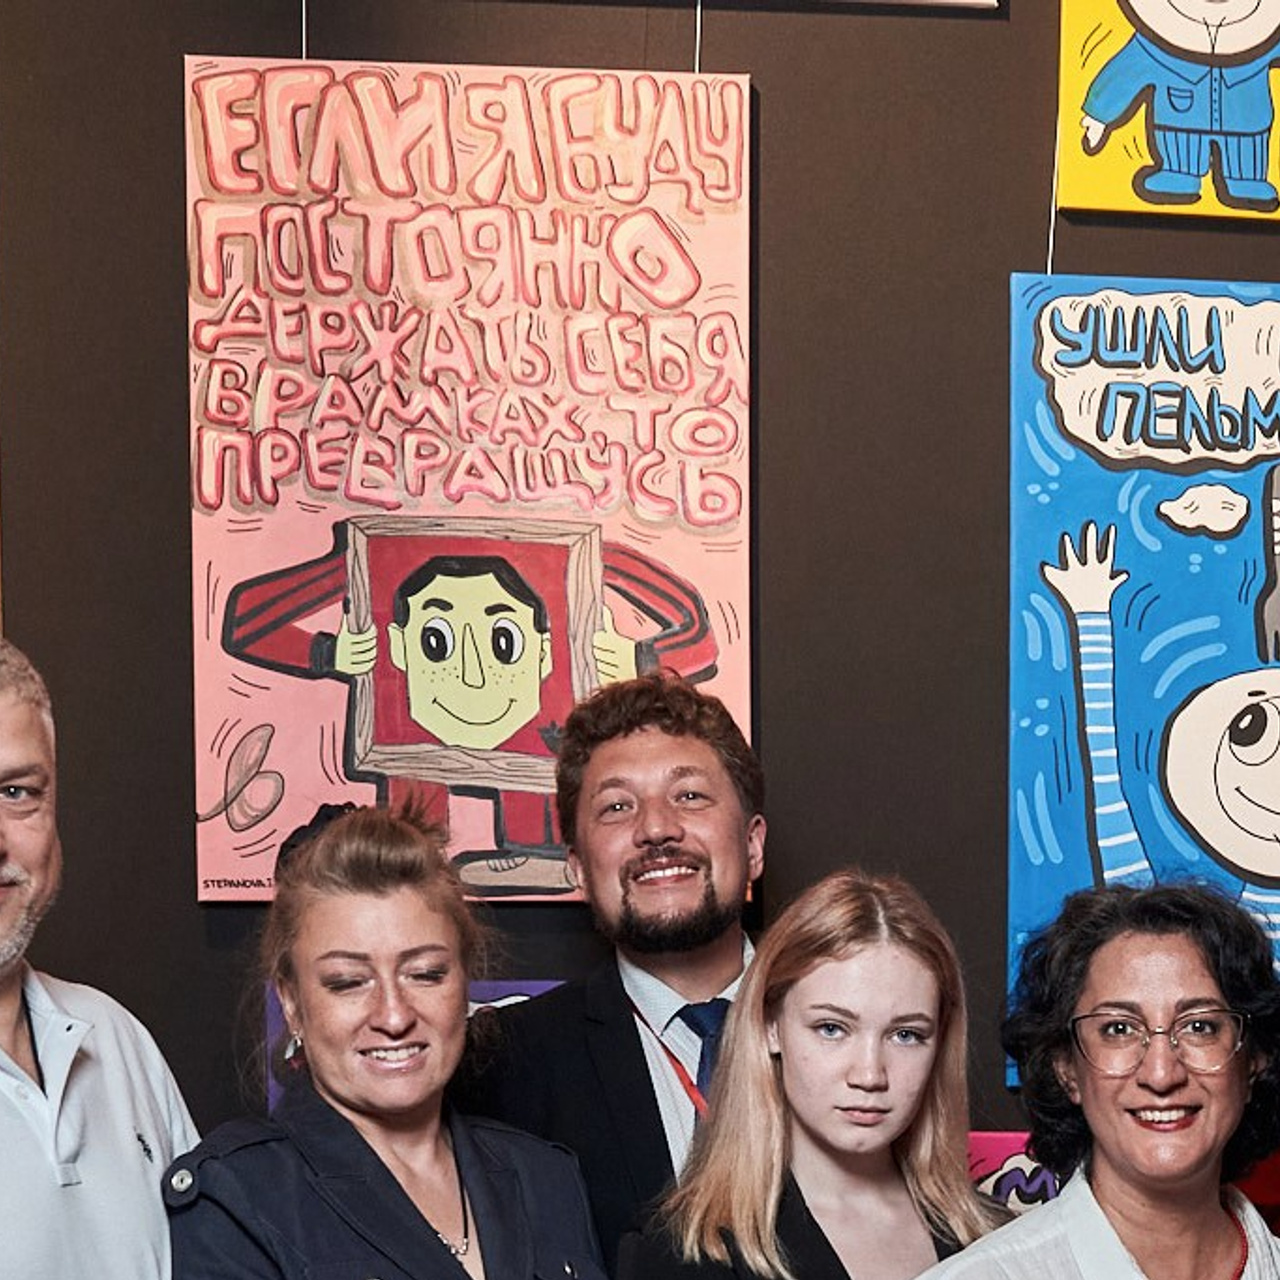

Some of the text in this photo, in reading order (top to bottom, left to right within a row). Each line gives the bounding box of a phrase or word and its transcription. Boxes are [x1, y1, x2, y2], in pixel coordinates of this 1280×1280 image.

[464, 74, 547, 204] Я
[541, 72, 743, 215] БУДУ
[194, 197, 701, 312] ПОСТОЯННО
[193, 285, 748, 406] ДЕРЖАТЬ СЕБЯ
[1049, 304, 1226, 376] УШЛИ
[203, 358, 253, 428] В
[604, 395, 740, 457] ТО
[196, 426, 742, 529] ПРЕВРАЩУСЬ
